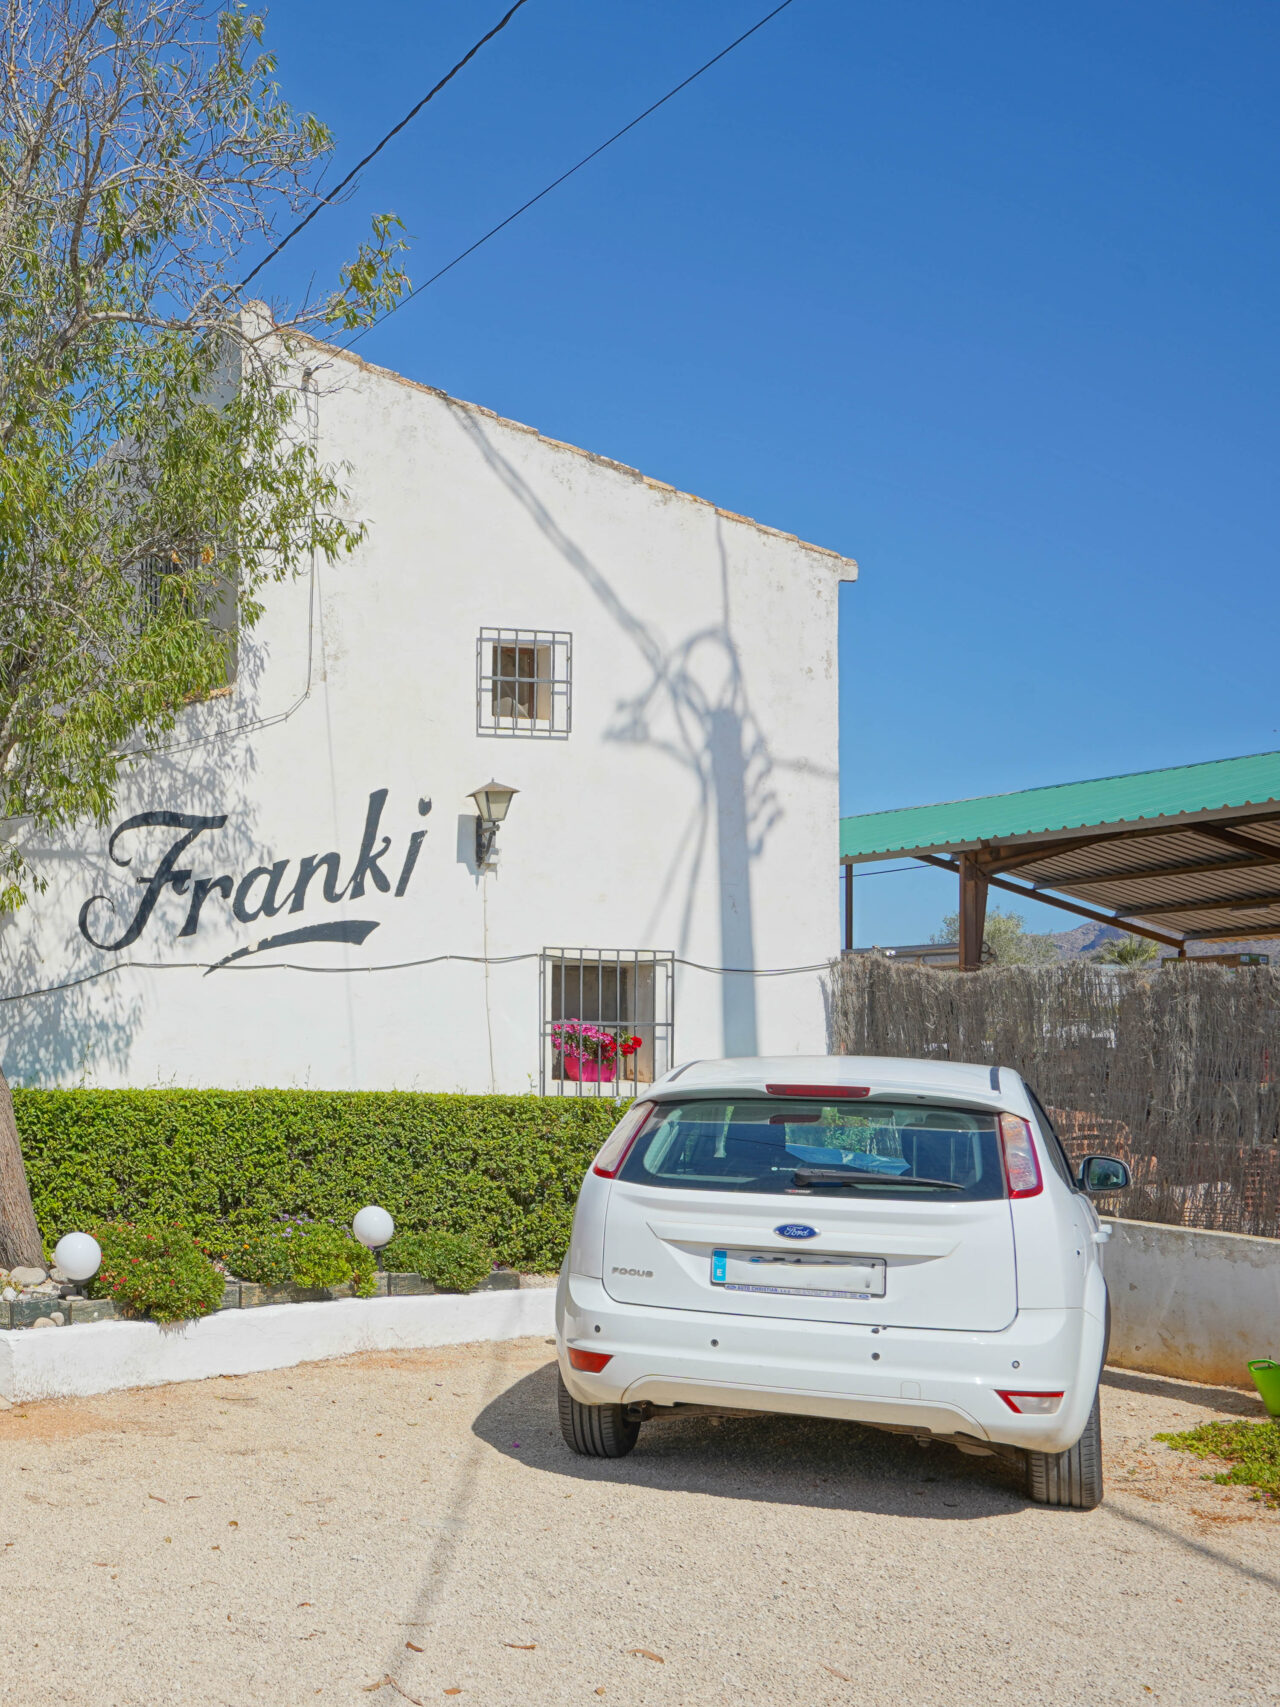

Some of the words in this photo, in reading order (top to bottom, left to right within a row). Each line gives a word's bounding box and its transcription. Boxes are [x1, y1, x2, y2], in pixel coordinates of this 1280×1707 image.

[78, 788, 432, 951] Franki
[783, 1226, 811, 1237] Ford
[611, 1266, 654, 1278] FOCUS
[716, 1268, 723, 1276] E
